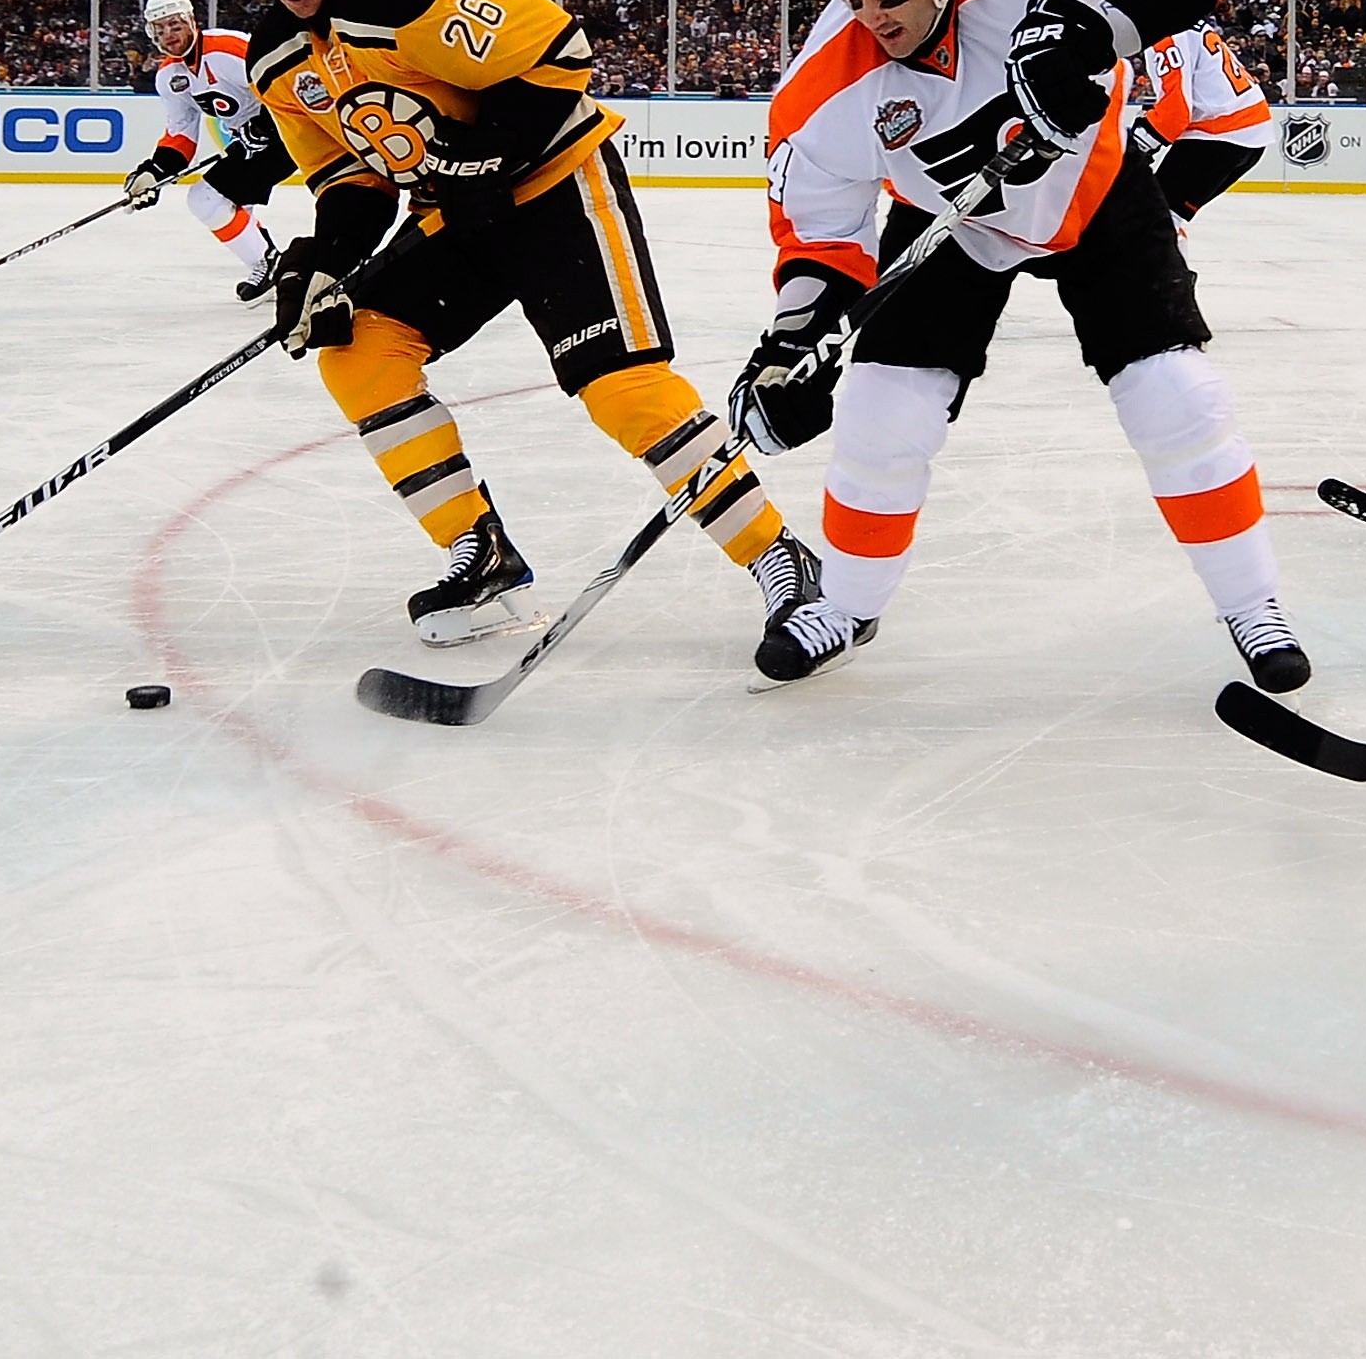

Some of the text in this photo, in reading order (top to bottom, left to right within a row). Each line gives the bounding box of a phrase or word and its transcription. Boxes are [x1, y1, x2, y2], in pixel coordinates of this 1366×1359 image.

[1154, 45, 1185, 78] 20
[1340, 136, 1362, 148] ON
[425, 156, 503, 177] AUER
[552, 317, 619, 360] BAUER
